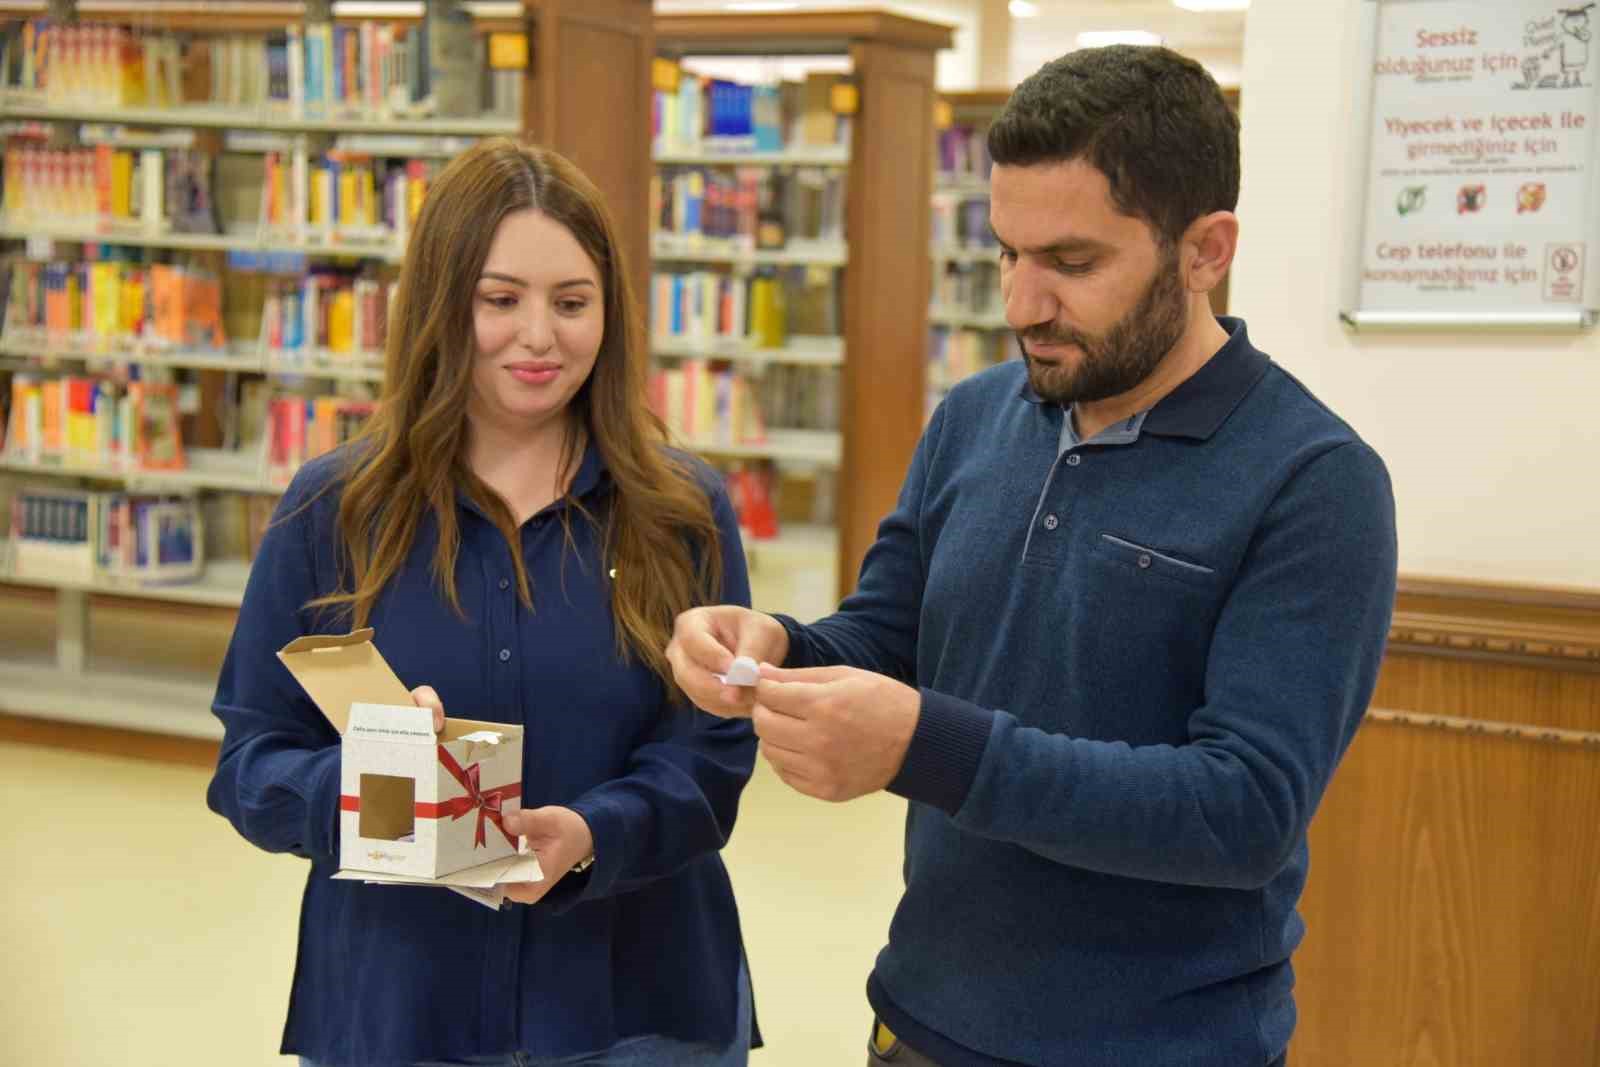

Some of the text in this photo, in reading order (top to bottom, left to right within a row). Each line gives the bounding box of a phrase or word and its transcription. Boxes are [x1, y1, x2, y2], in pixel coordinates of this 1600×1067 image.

[1416, 28, 1477, 48] Sessiz
[1482, 52, 1519, 73] için
[1462, 118, 1484, 130] ve
[1524, 137, 1557, 155] için
[1376, 243, 1411, 261] Cep
[1418, 243, 1497, 259] telefonu
[1504, 266, 1537, 284] için
